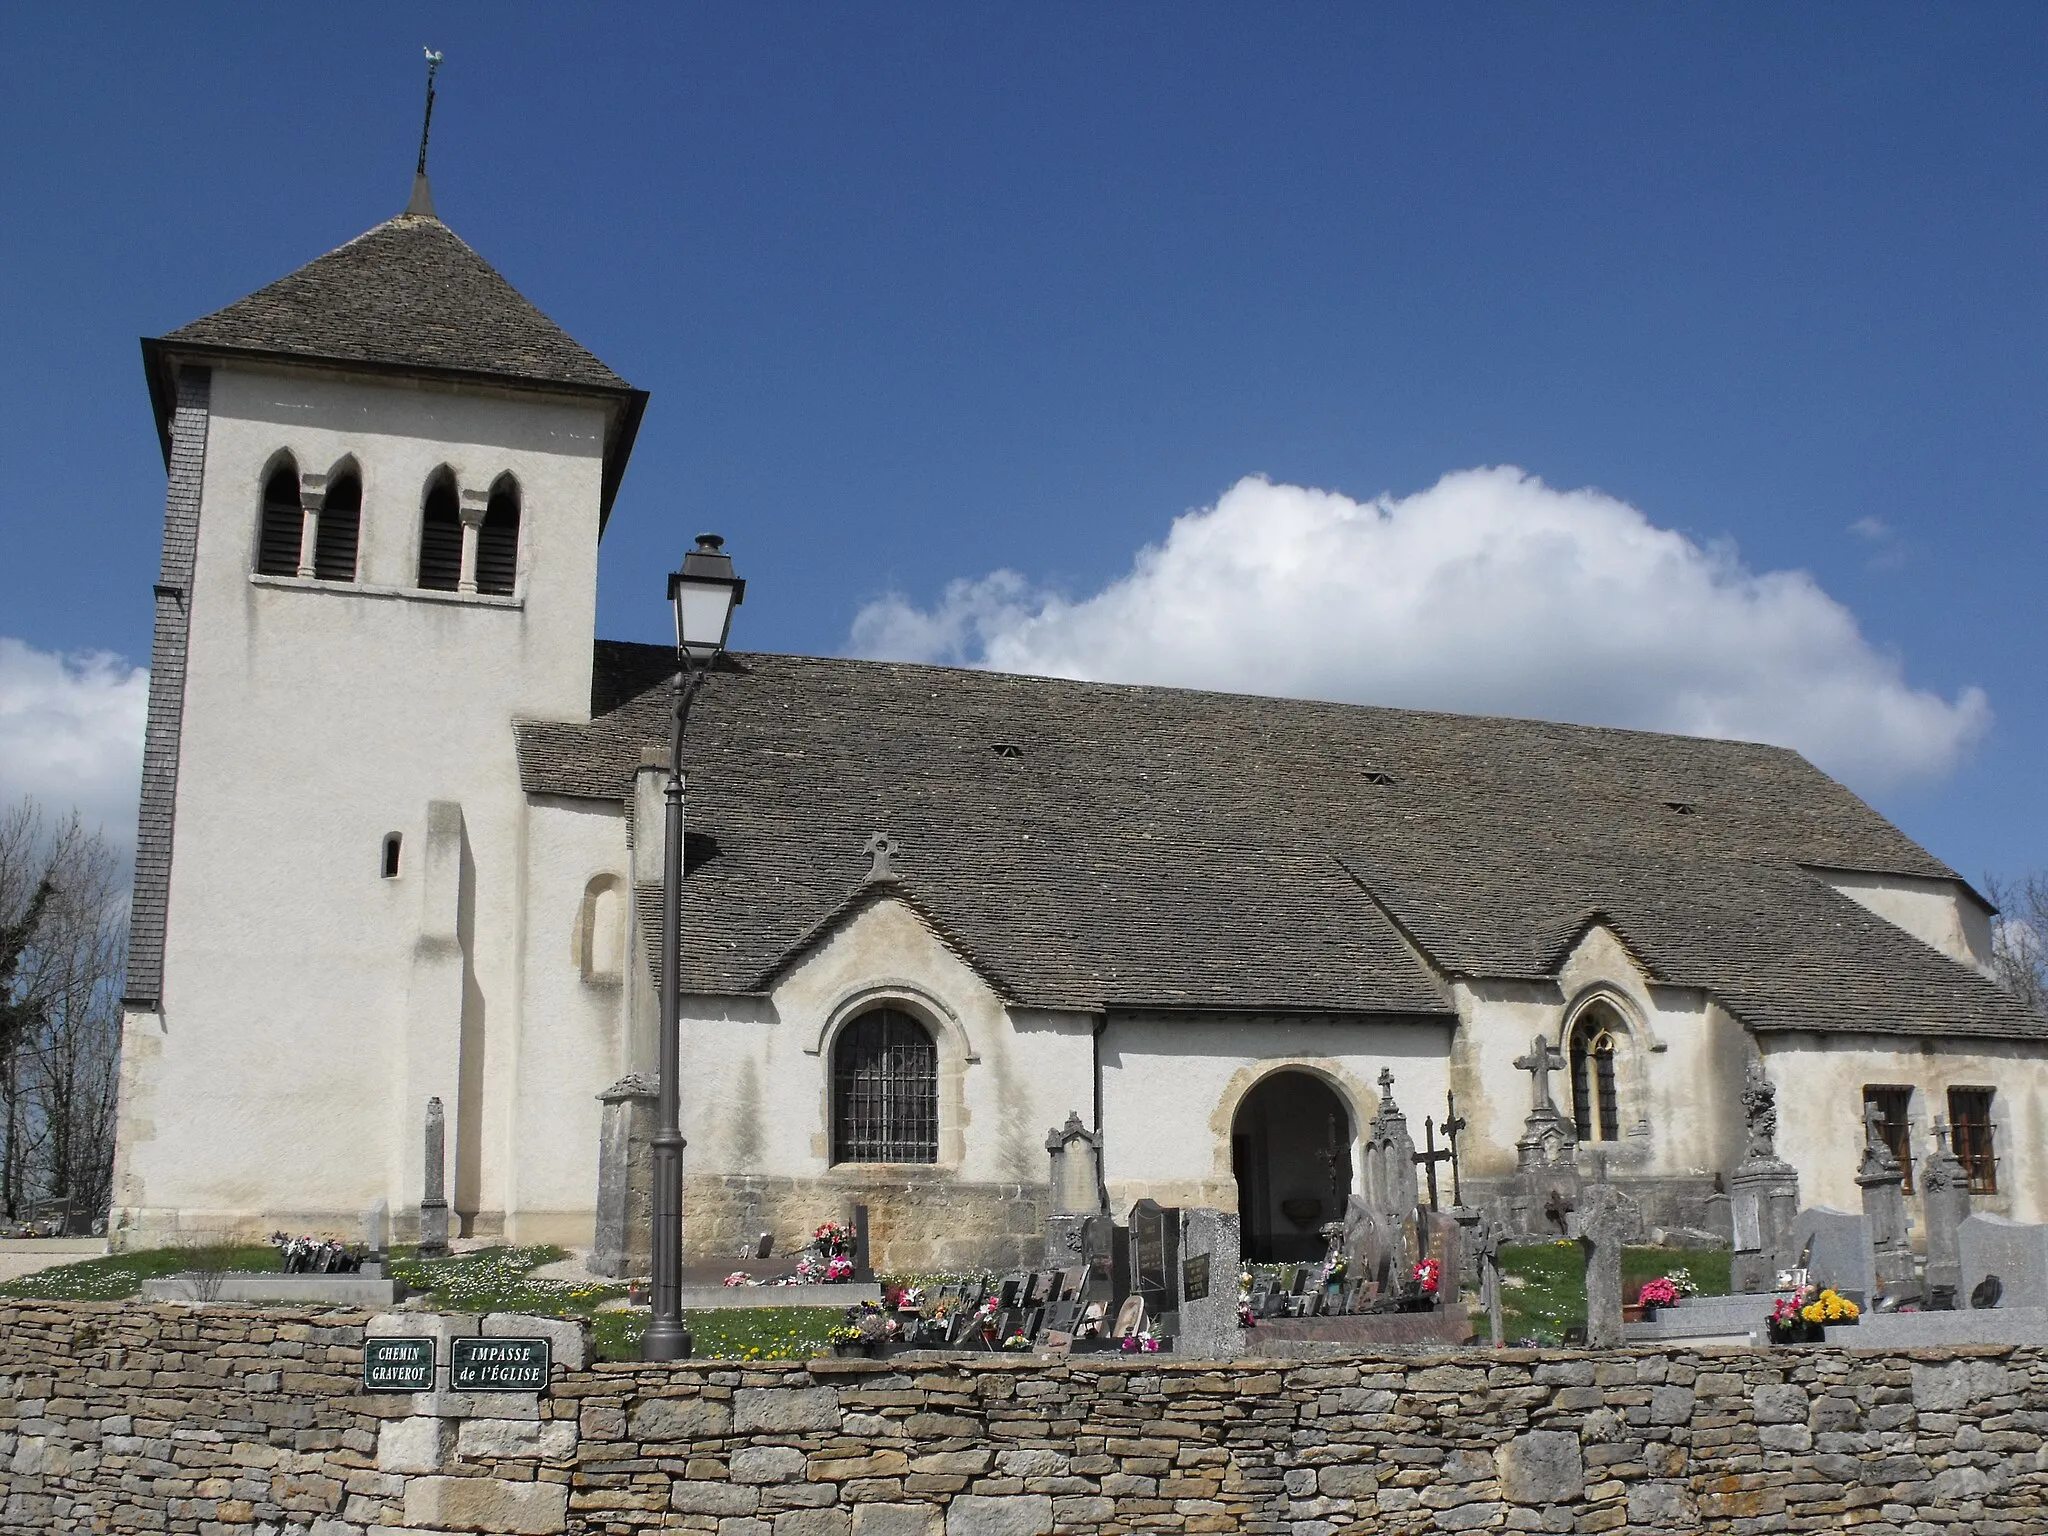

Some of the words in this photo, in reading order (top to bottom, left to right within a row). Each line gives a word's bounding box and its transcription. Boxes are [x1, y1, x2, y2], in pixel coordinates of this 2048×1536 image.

[378, 1347, 420, 1361] CHEMIN
[470, 1347, 531, 1361] IMPASSE
[372, 1366, 426, 1381] GRAVEROT
[459, 1366, 476, 1381] de
